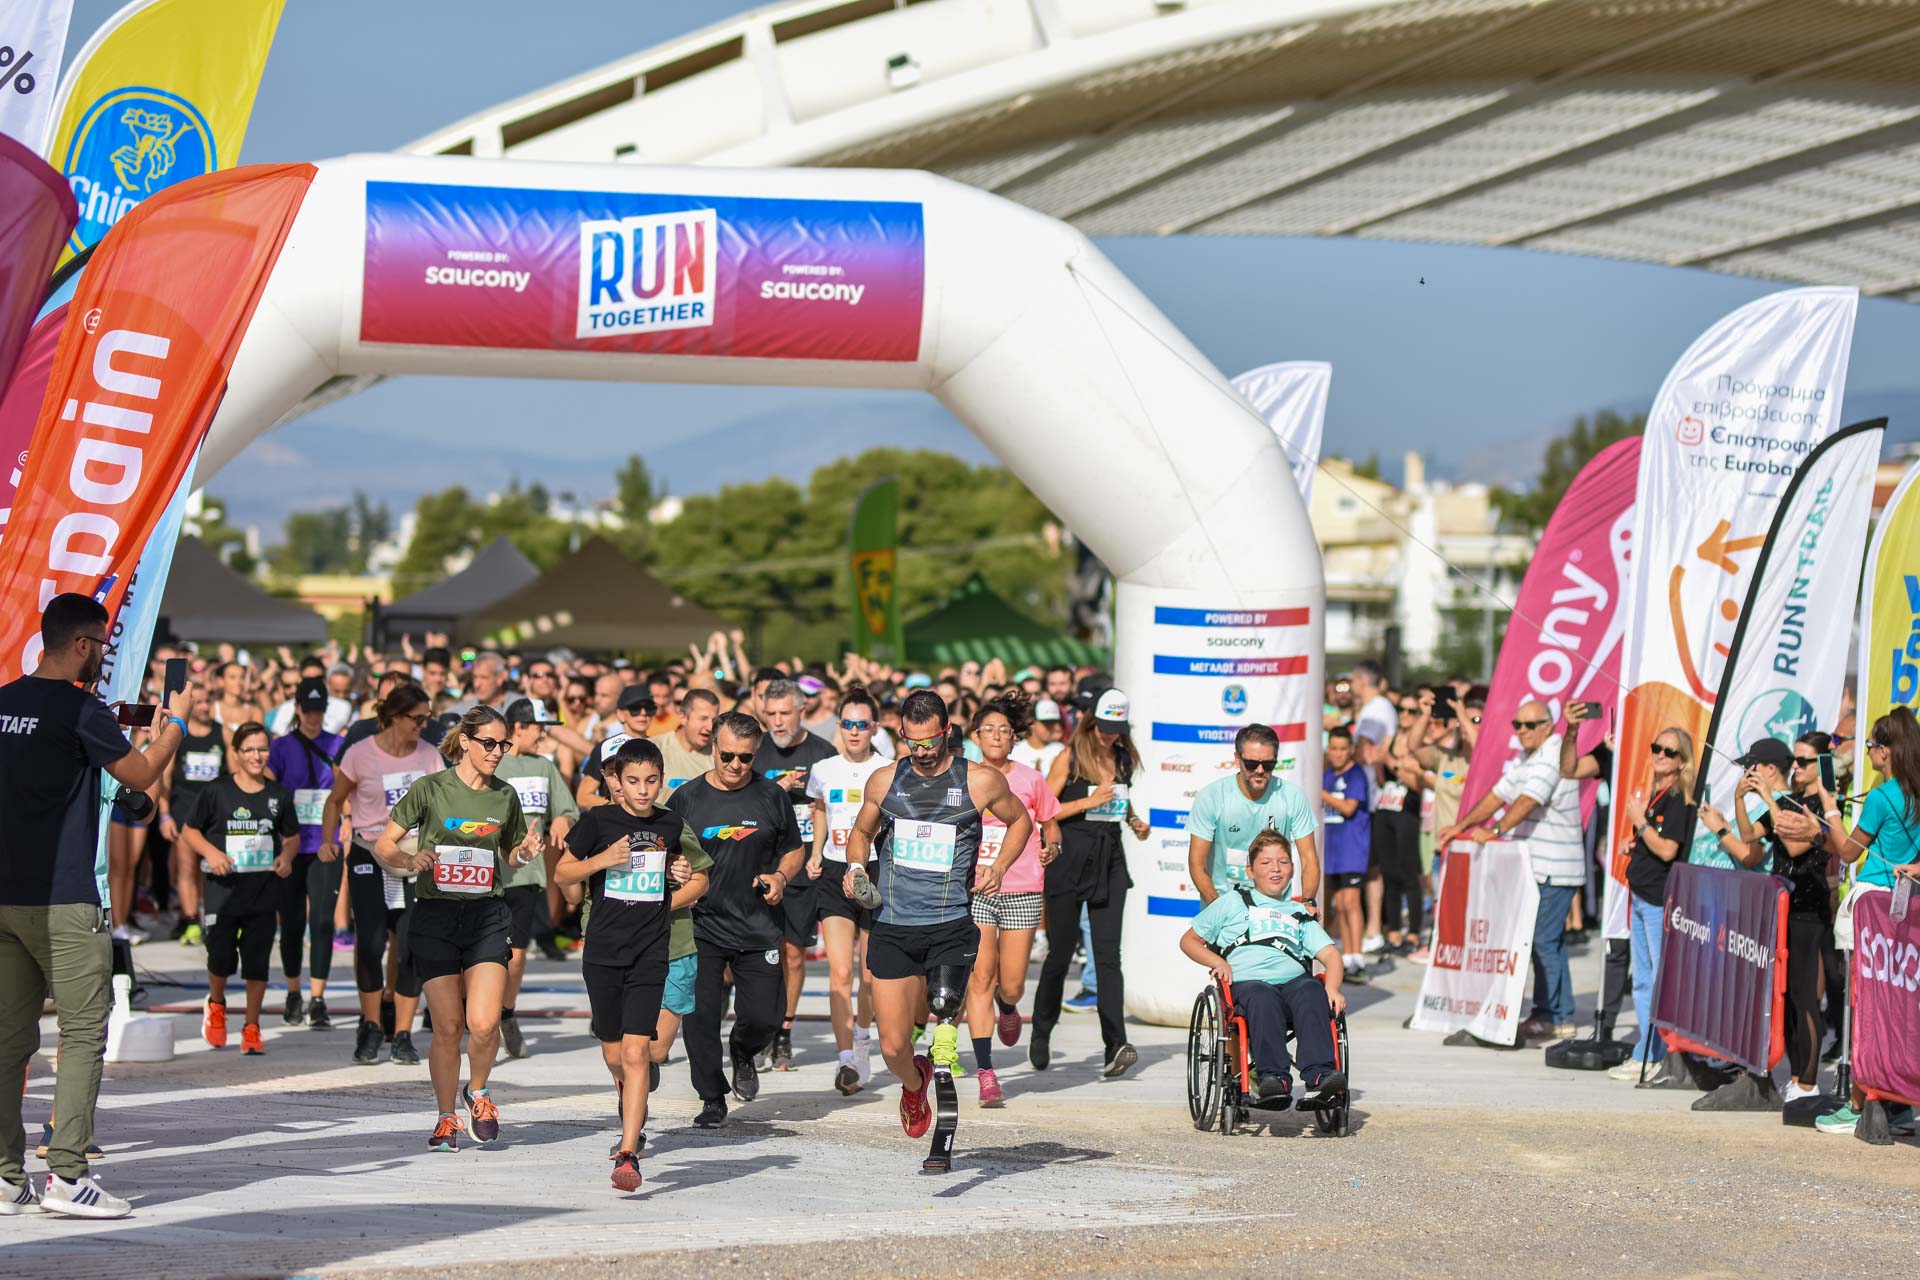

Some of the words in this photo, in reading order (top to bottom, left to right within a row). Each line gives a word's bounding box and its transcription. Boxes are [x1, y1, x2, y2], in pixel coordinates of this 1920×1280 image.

[447, 249, 494, 262] POWERED
[590, 220, 706, 306] RUN
[424, 265, 531, 293] saucony
[782, 263, 828, 275] POWERED
[760, 280, 865, 305] saucony
[589, 301, 705, 330] TOGETHER
[1718, 375, 1826, 400] Πρόγραμμα
[1692, 400, 1825, 428] επιβράβευσης
[1689, 454, 1719, 472] της
[1205, 613, 1252, 625] POWERED
[1254, 613, 1268, 624] BY
[1207, 635, 1265, 649] saucony
[227, 820, 258, 831] PROTEIN
[896, 840, 949, 863] 3104
[438, 864, 490, 884] 3520
[608, 870, 661, 891] 3104
[1253, 919, 1296, 937] 3134
[1861, 926, 1920, 993] sauc
